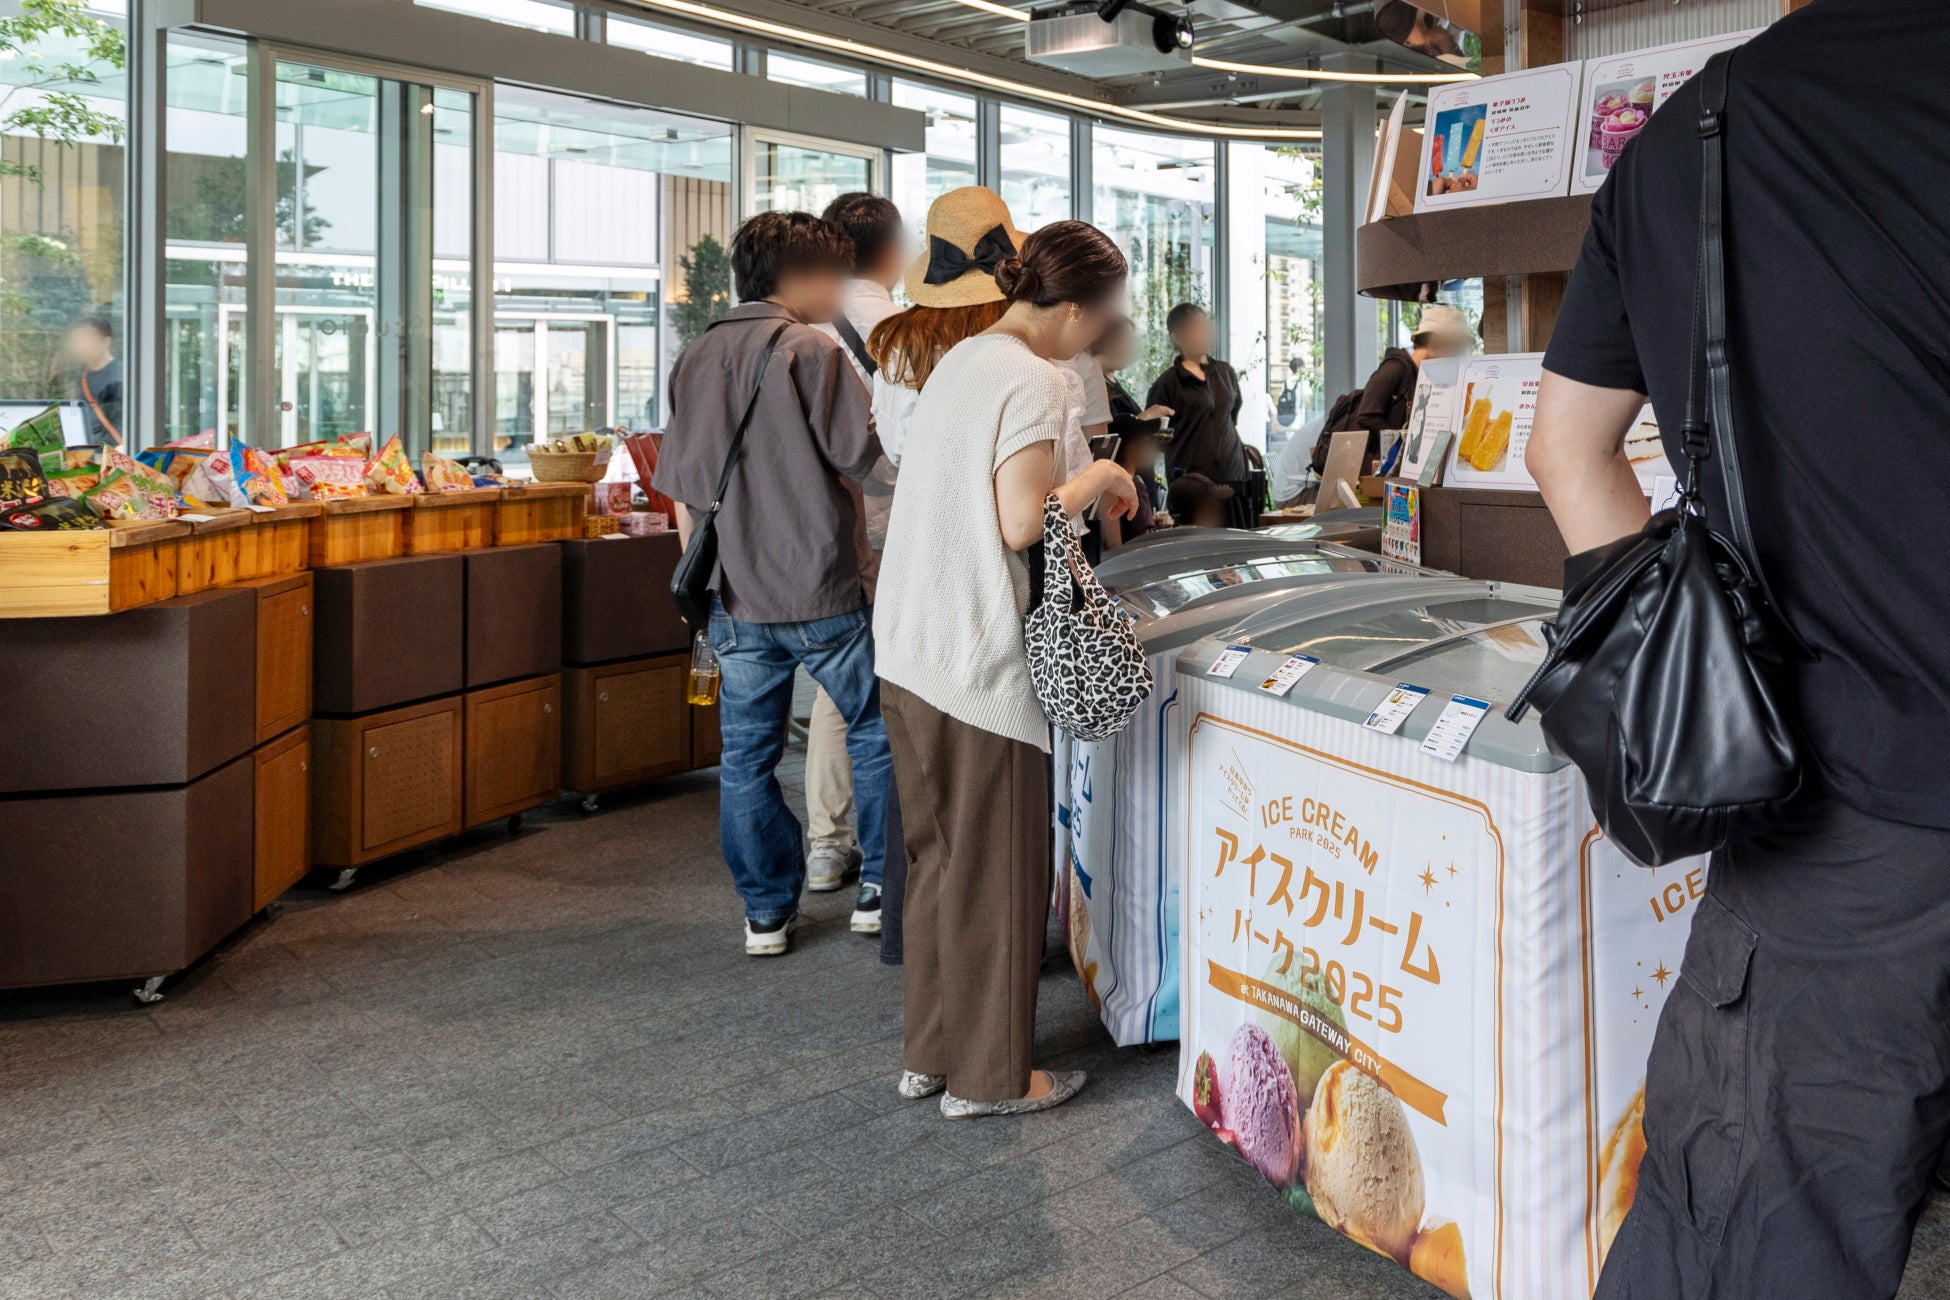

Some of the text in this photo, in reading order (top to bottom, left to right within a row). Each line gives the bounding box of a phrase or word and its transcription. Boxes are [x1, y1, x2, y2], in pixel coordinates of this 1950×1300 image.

[1489, 125, 1516, 133] くずアイス
[330, 272, 374, 287] THE
[1261, 796, 1379, 876] ICE CREAM
[1290, 827, 1342, 860] PARK 2025
[1214, 826, 1441, 985] アイスクリーム
[1650, 867, 1706, 924] ICE
[1231, 909, 1404, 1034] パーク2025
[1240, 983, 1382, 1076] at TAKANAWA GATEWAY CITY
